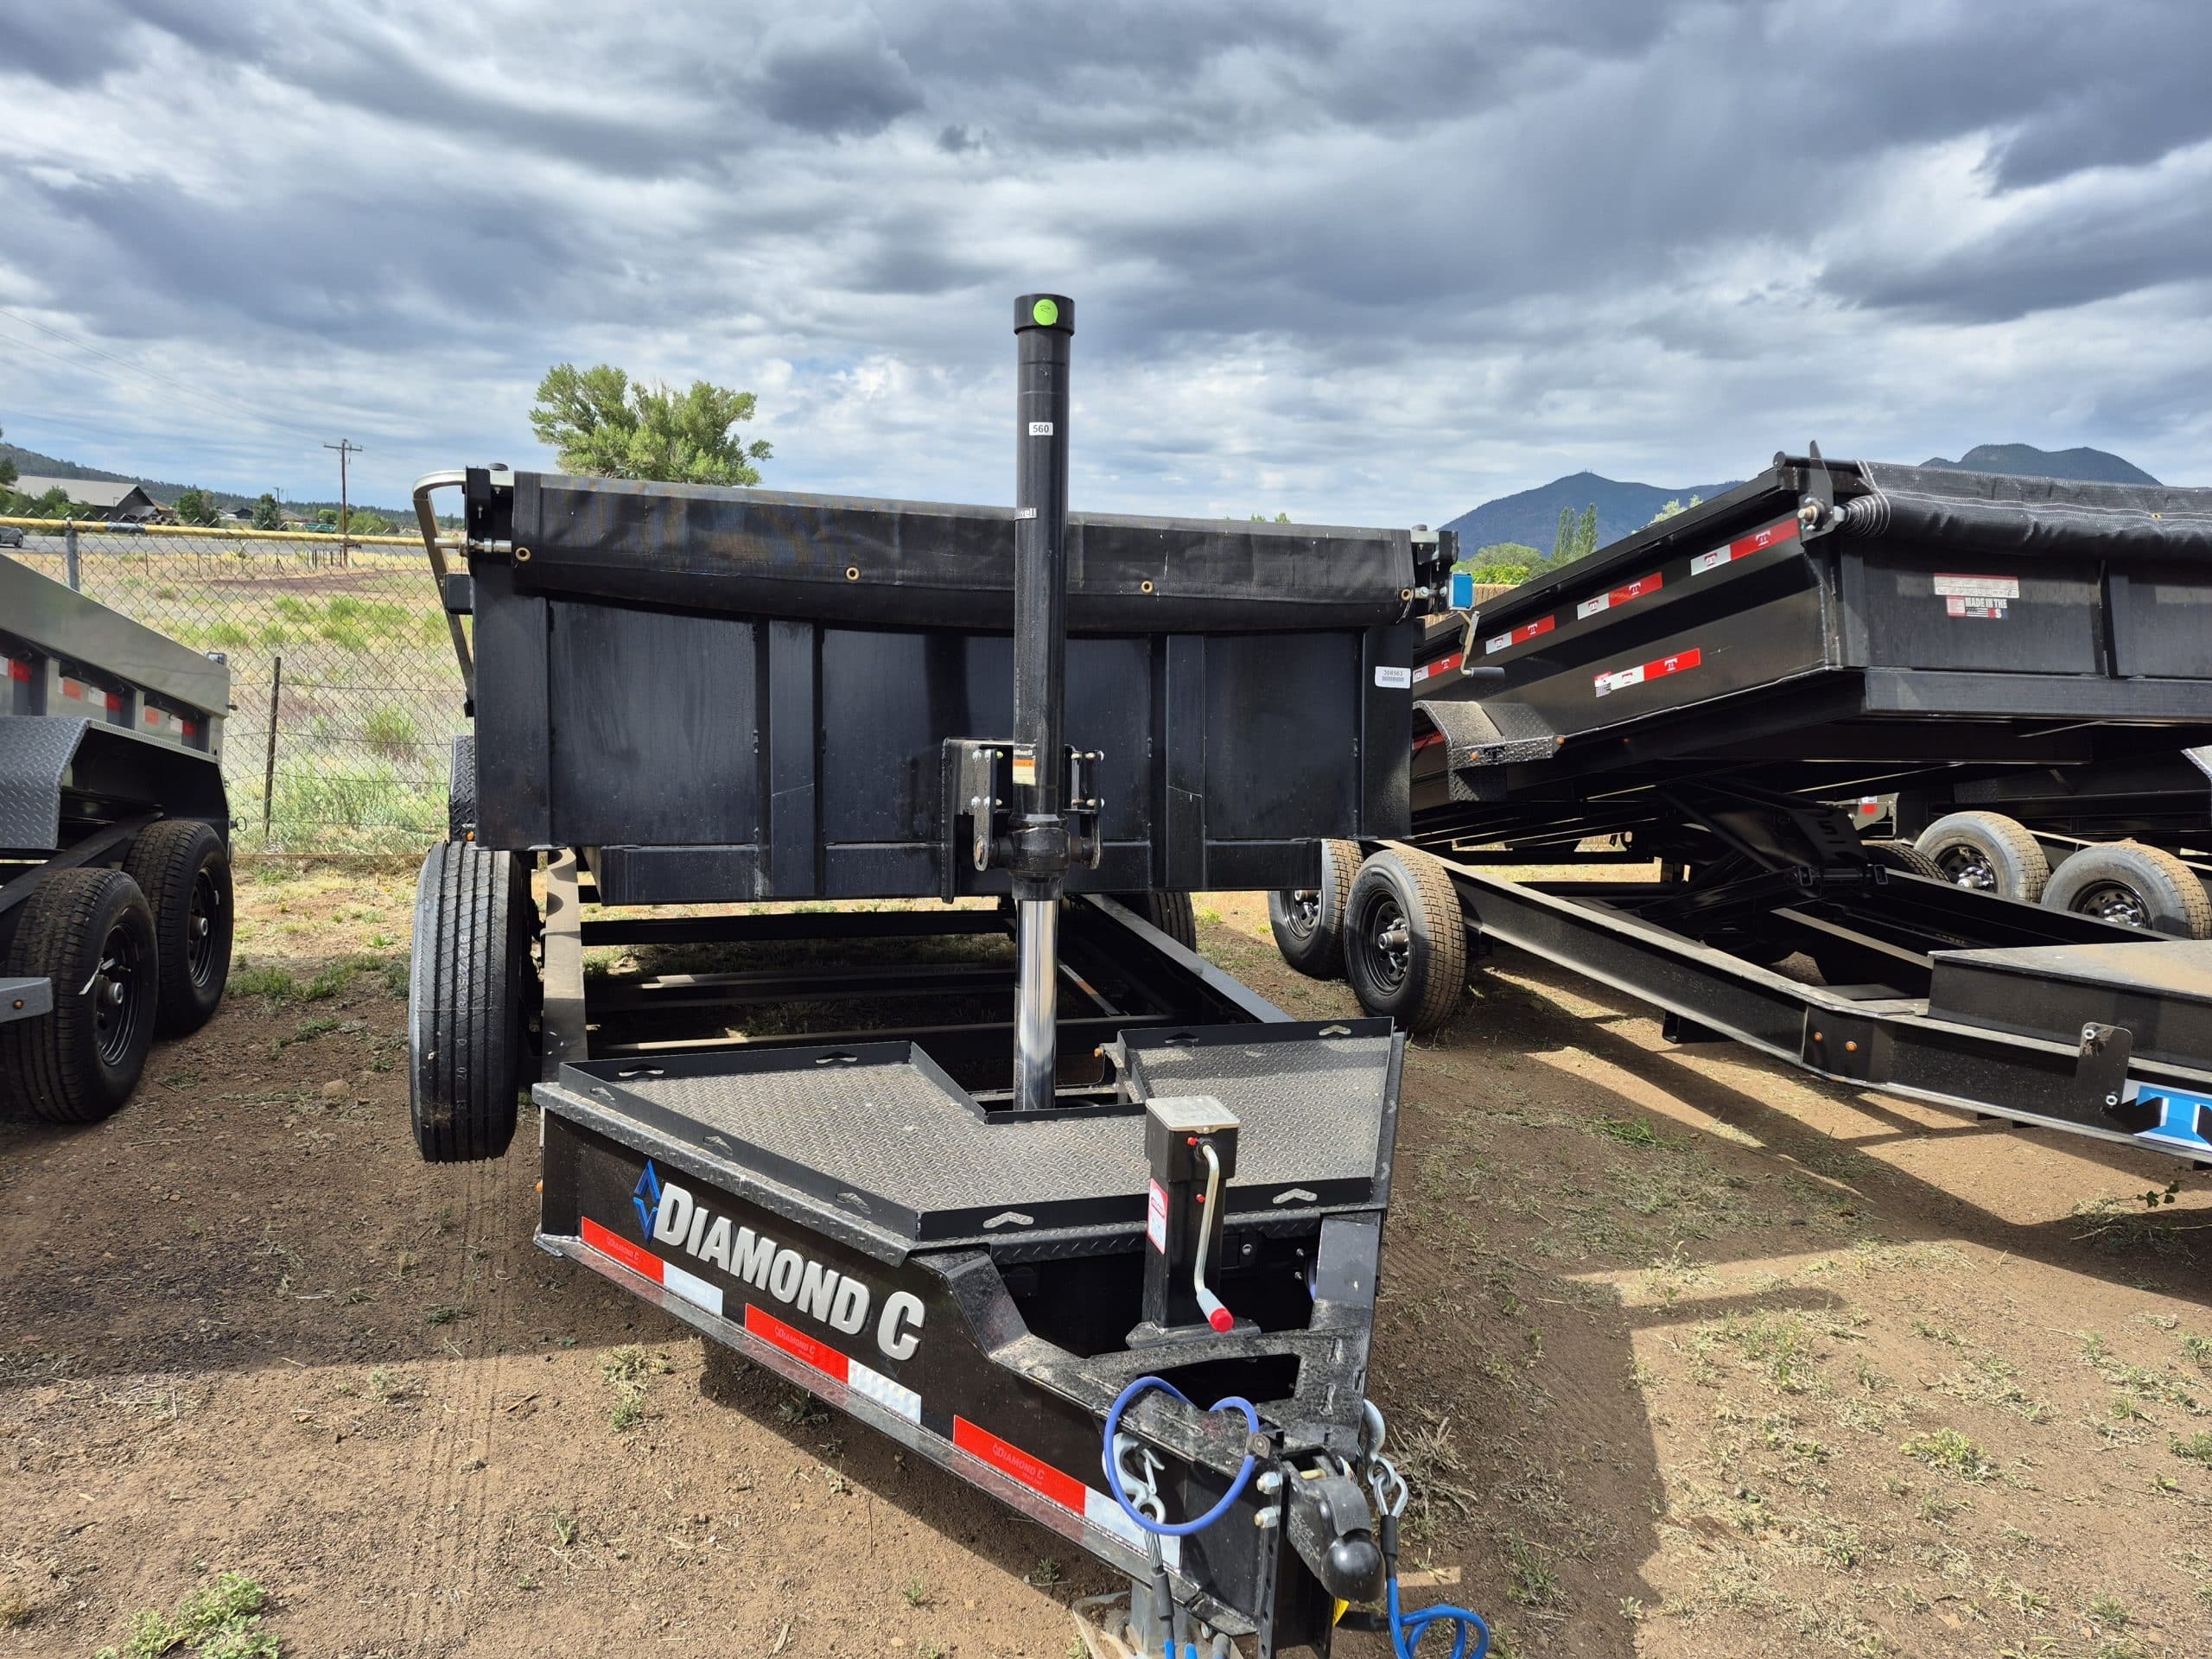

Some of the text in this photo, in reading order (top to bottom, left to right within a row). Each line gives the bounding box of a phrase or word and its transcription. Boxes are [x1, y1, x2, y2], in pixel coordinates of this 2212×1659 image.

[1033, 424, 1049, 433] 560
[1993, 598, 2007, 608] THE
[653, 1182, 925, 1362] DIAMOND C
[778, 1328, 809, 1352] DIAMOND
[809, 1344, 816, 1356] C
[997, 1446, 1046, 1480] DIAMOND C
